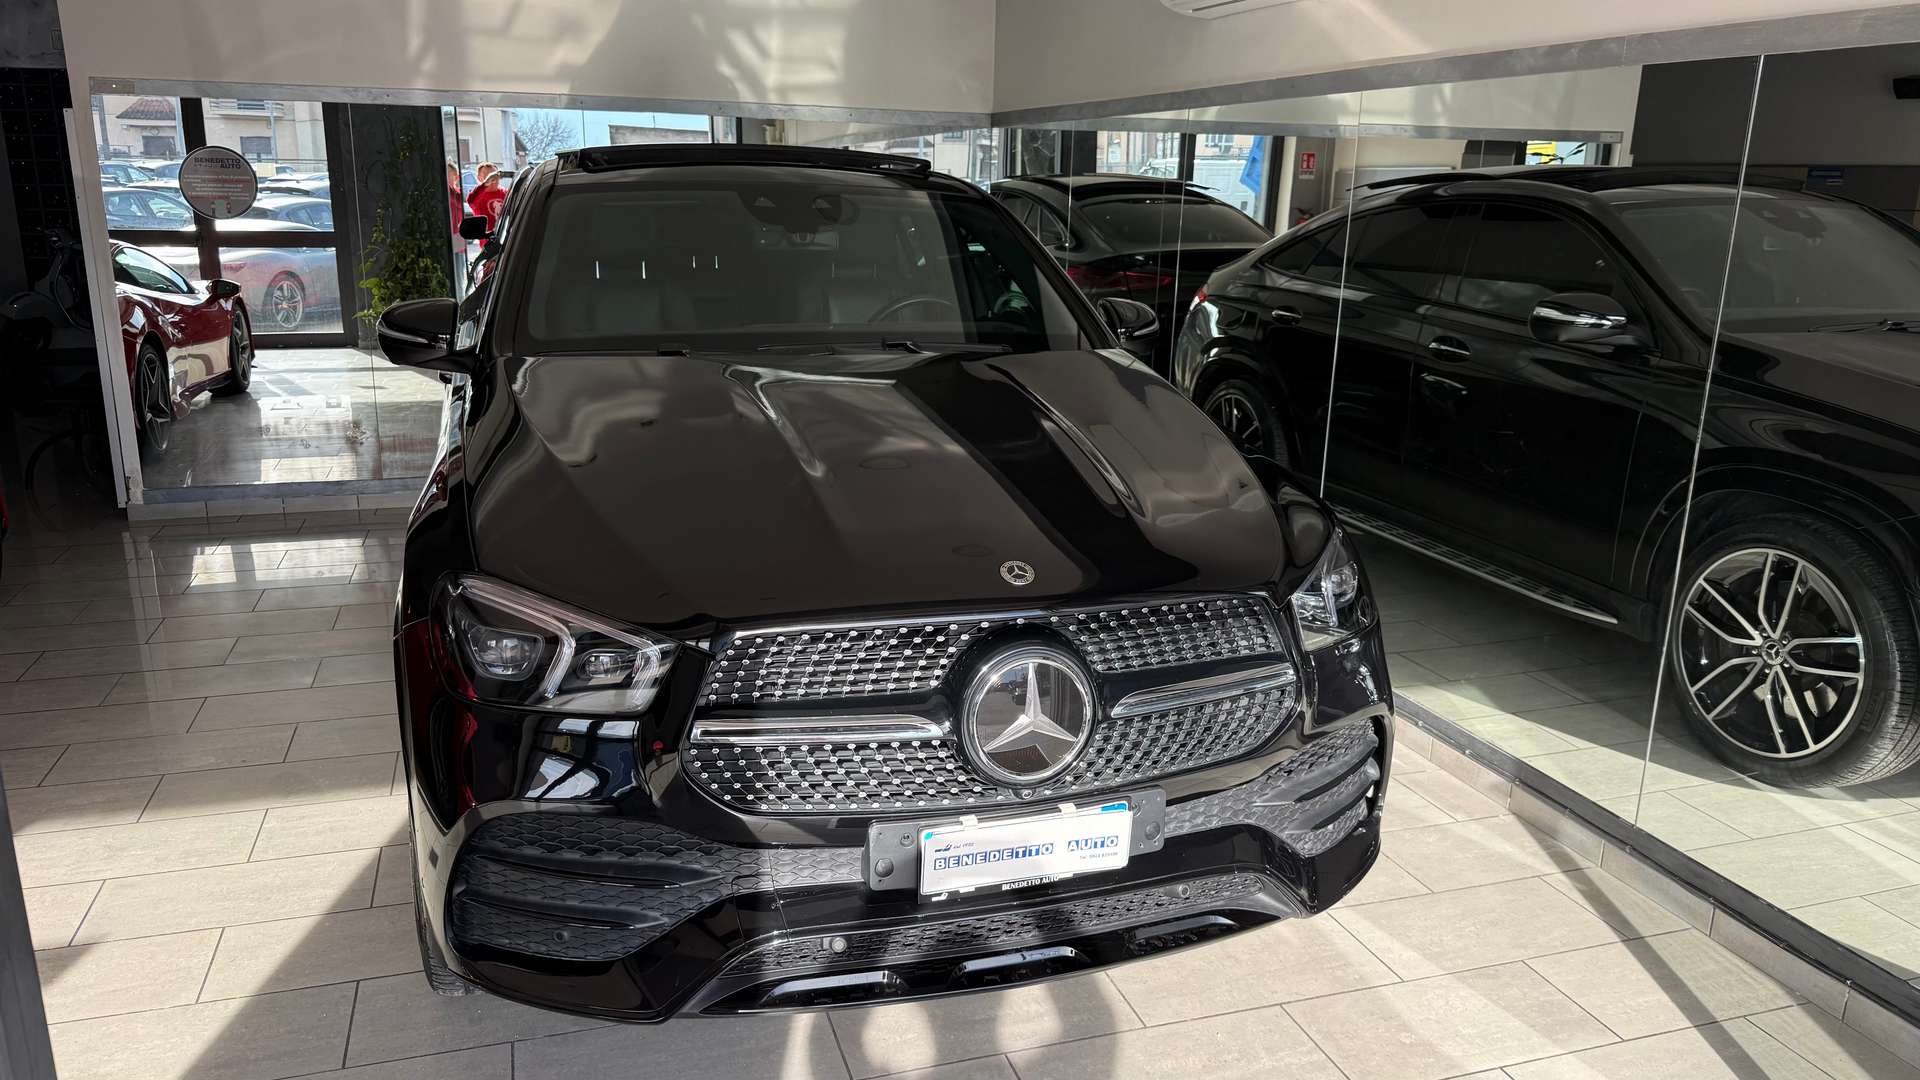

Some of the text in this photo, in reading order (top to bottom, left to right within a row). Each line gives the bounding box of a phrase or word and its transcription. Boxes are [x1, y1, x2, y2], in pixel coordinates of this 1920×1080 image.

[934, 835, 1119, 870] BENEDETTO AUTO
[1002, 874, 1060, 891] BENEDETTO AUTO
